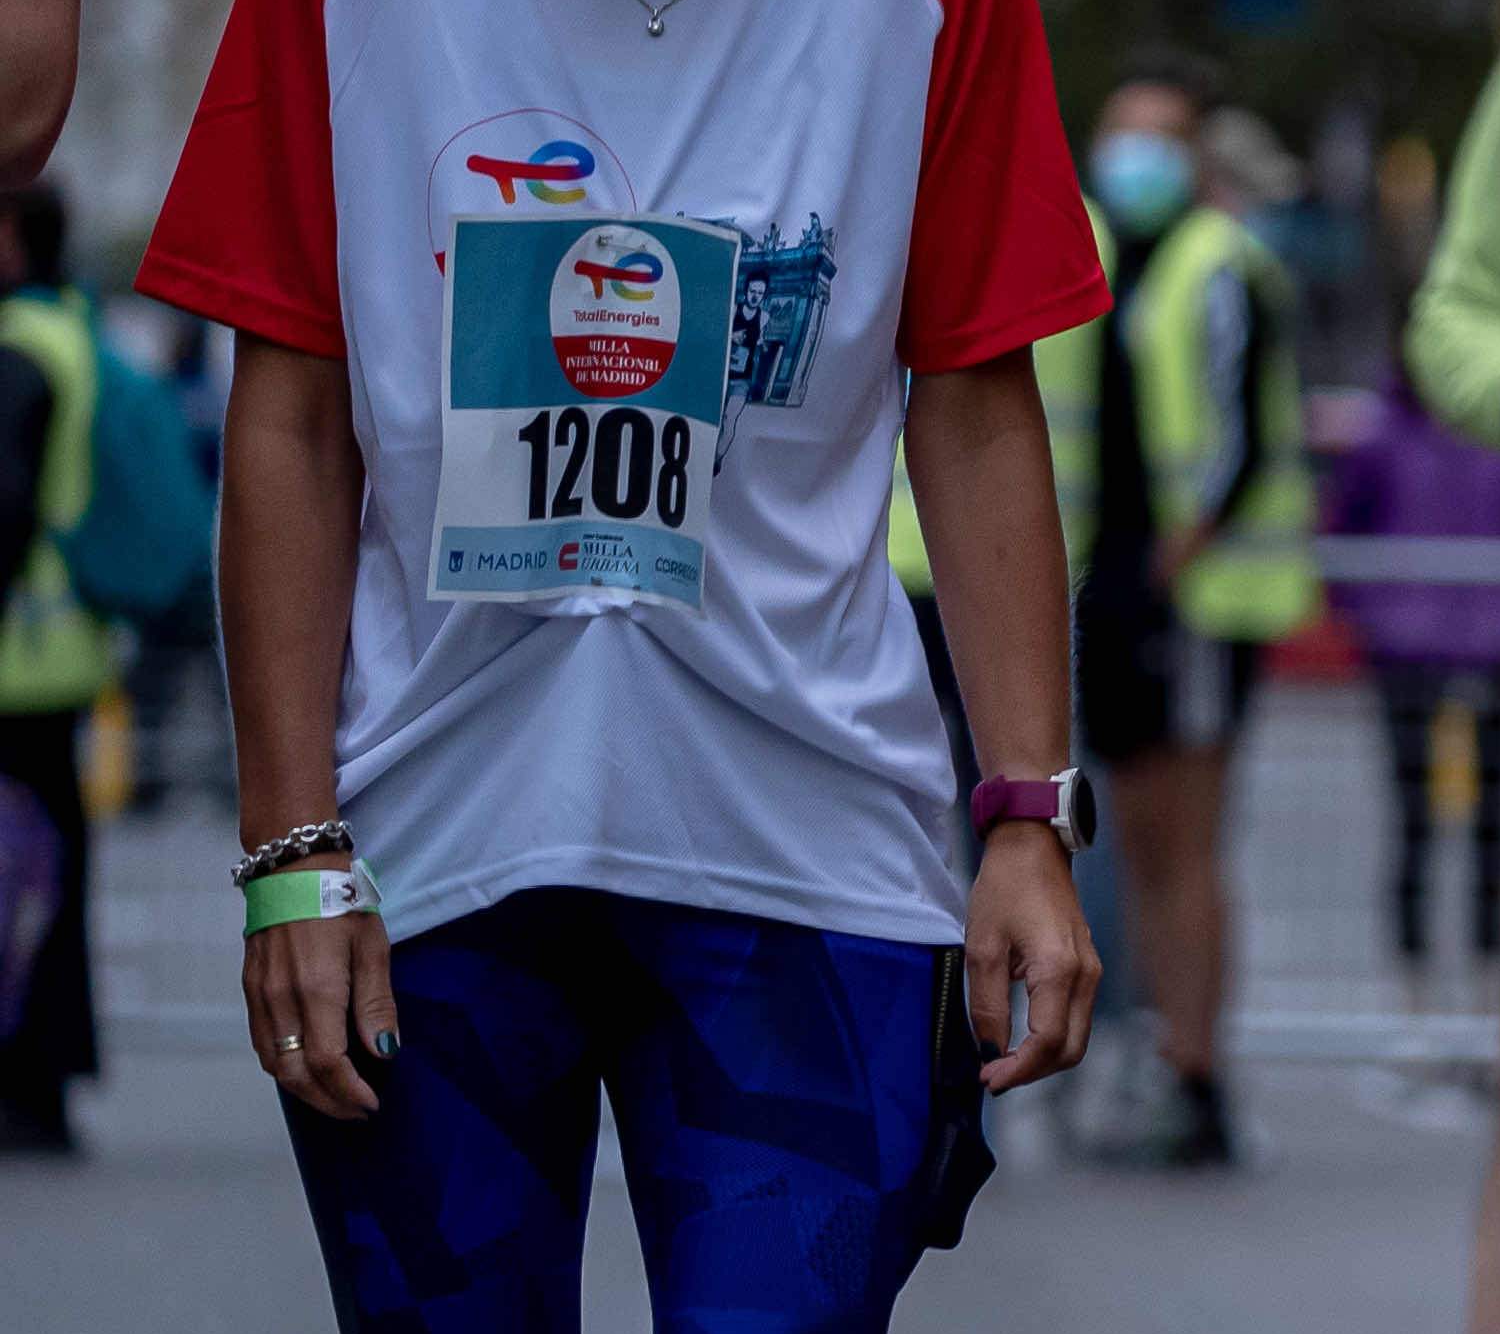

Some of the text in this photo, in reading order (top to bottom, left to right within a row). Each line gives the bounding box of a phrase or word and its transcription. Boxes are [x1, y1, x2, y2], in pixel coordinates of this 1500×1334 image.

[573, 309, 660, 327] TotalEnergies
[589, 339, 630, 353] MILLA
[576, 370, 646, 386] DE MADRID
[518, 407, 691, 529] 1208
[583, 542, 633, 558] MILLA
[477, 551, 547, 571] MADRID
